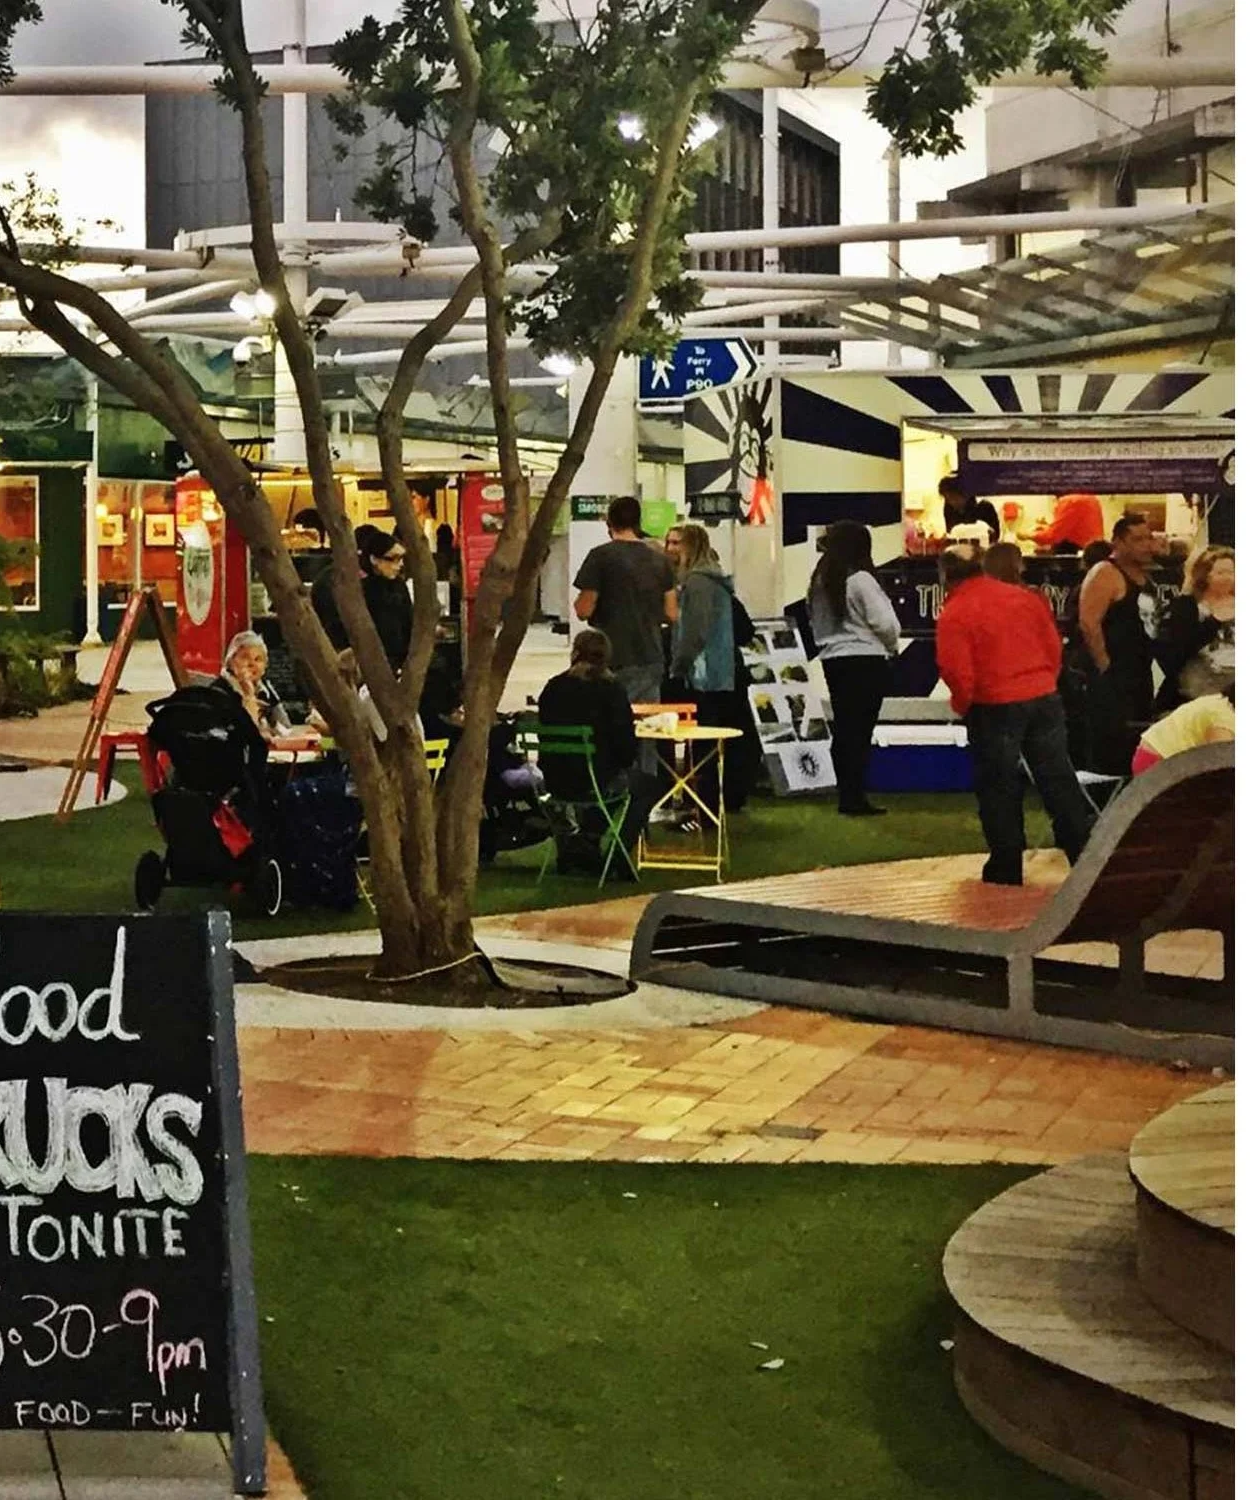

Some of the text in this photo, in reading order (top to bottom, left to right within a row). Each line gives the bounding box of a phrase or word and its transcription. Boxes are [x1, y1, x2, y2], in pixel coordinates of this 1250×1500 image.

[693, 345, 706, 355] To
[687, 356, 712, 366] Ferry
[685, 378, 713, 391] P90
[987, 445, 1017, 458] Why
